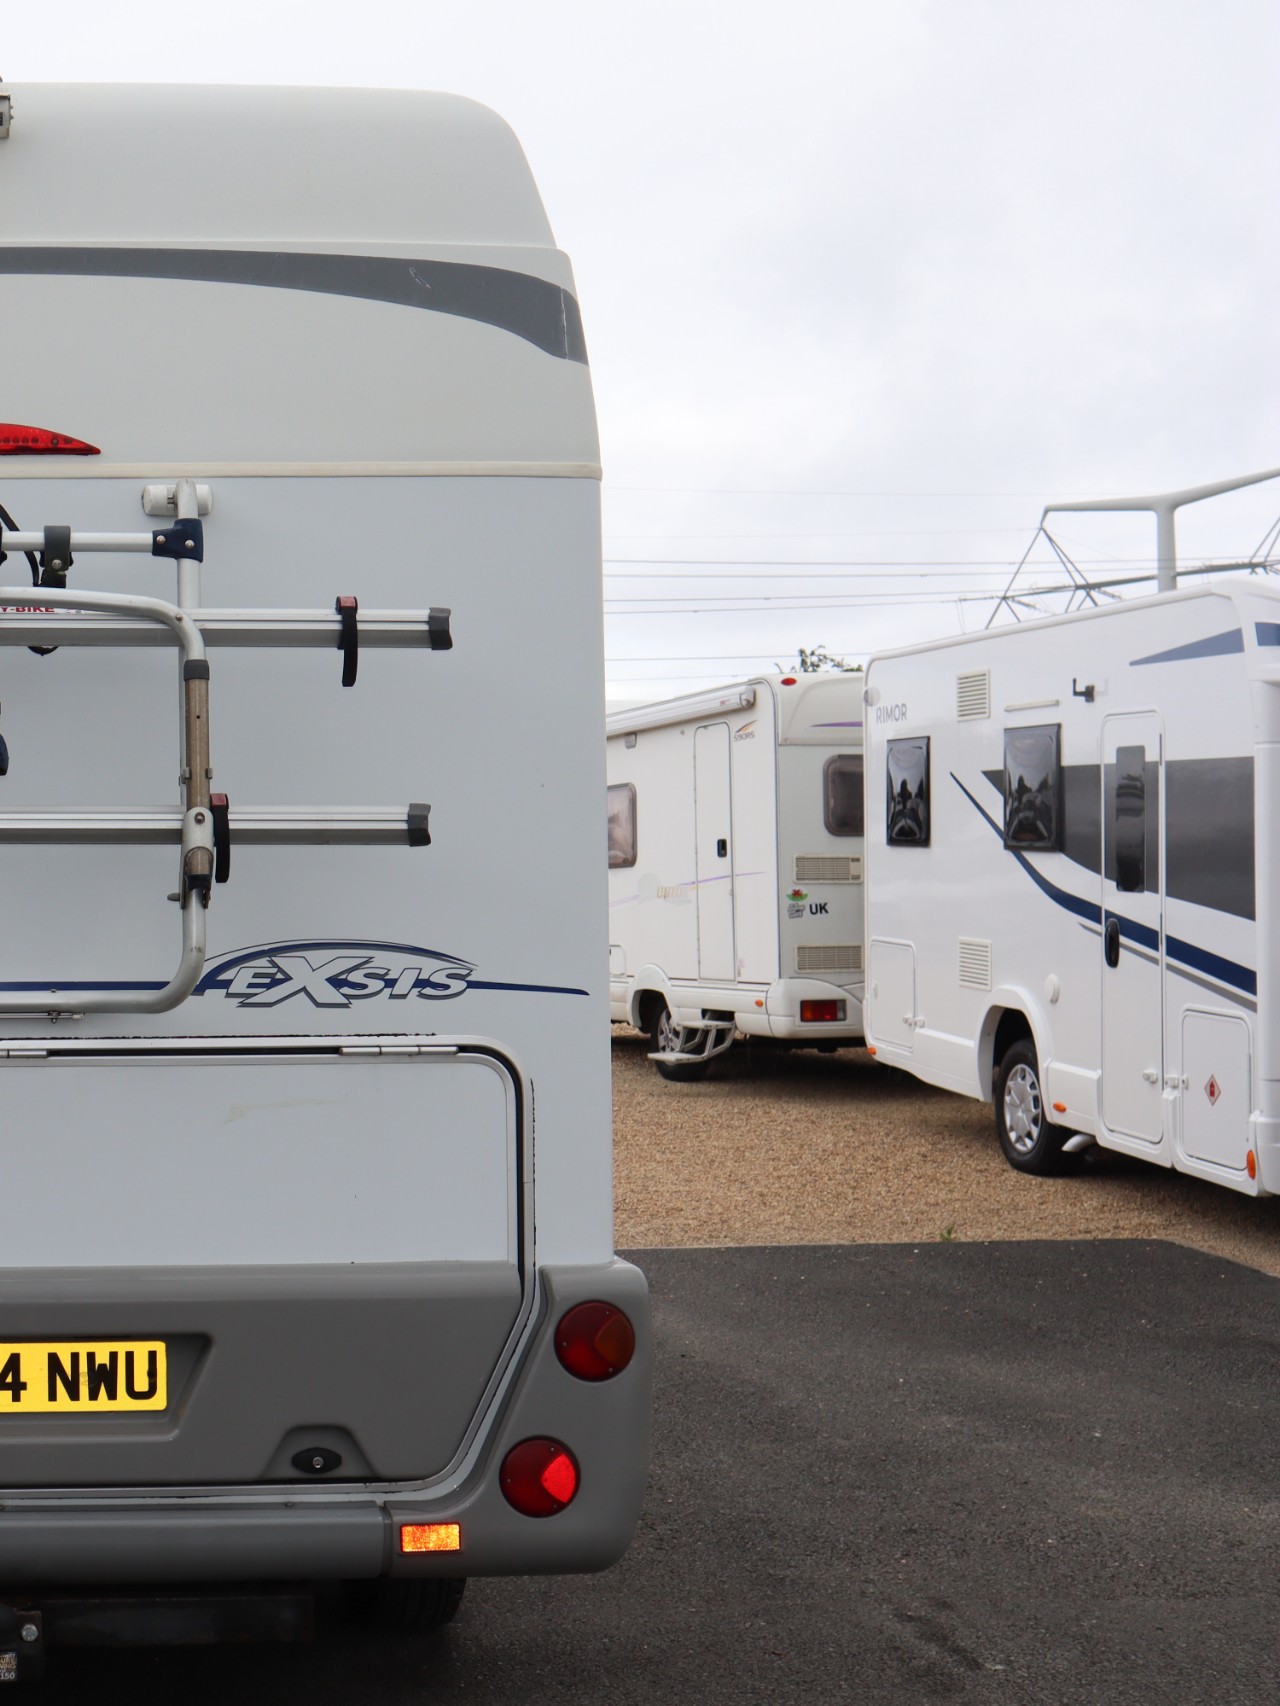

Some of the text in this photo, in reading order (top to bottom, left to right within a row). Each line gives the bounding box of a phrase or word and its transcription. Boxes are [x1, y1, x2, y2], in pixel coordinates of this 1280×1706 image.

[876, 703, 908, 725] RIMOR
[809, 902, 829, 915] UK
[47, 1349, 158, 1402] NWU
